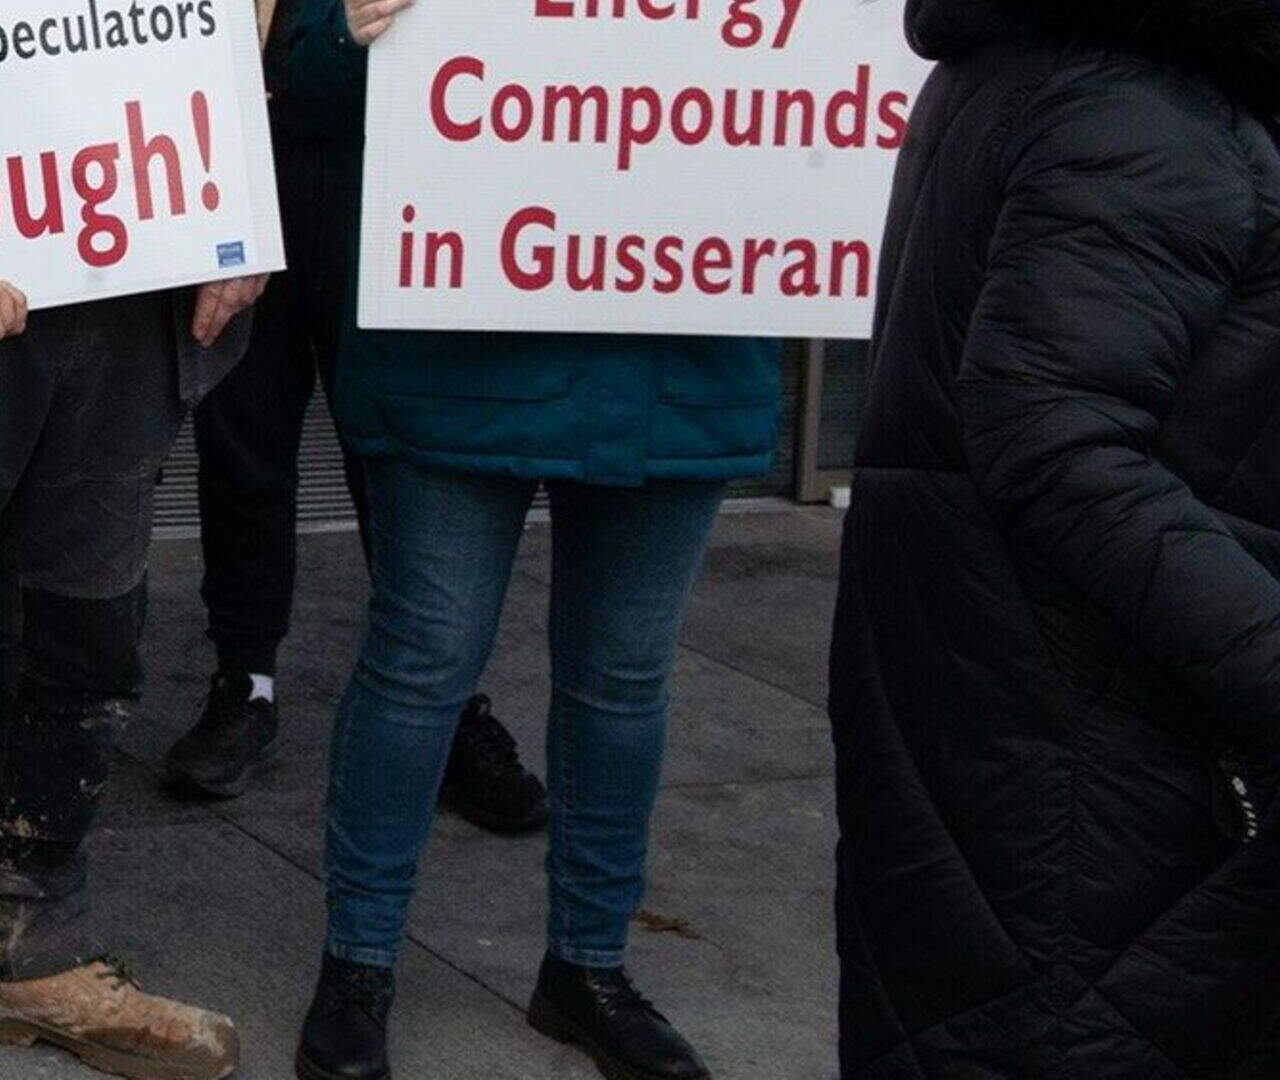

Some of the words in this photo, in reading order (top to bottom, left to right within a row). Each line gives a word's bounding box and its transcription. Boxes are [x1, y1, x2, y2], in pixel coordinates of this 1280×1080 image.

[429, 56, 908, 171] Compounds
[399, 205, 463, 289] in
[500, 206, 871, 298] Gusseran
